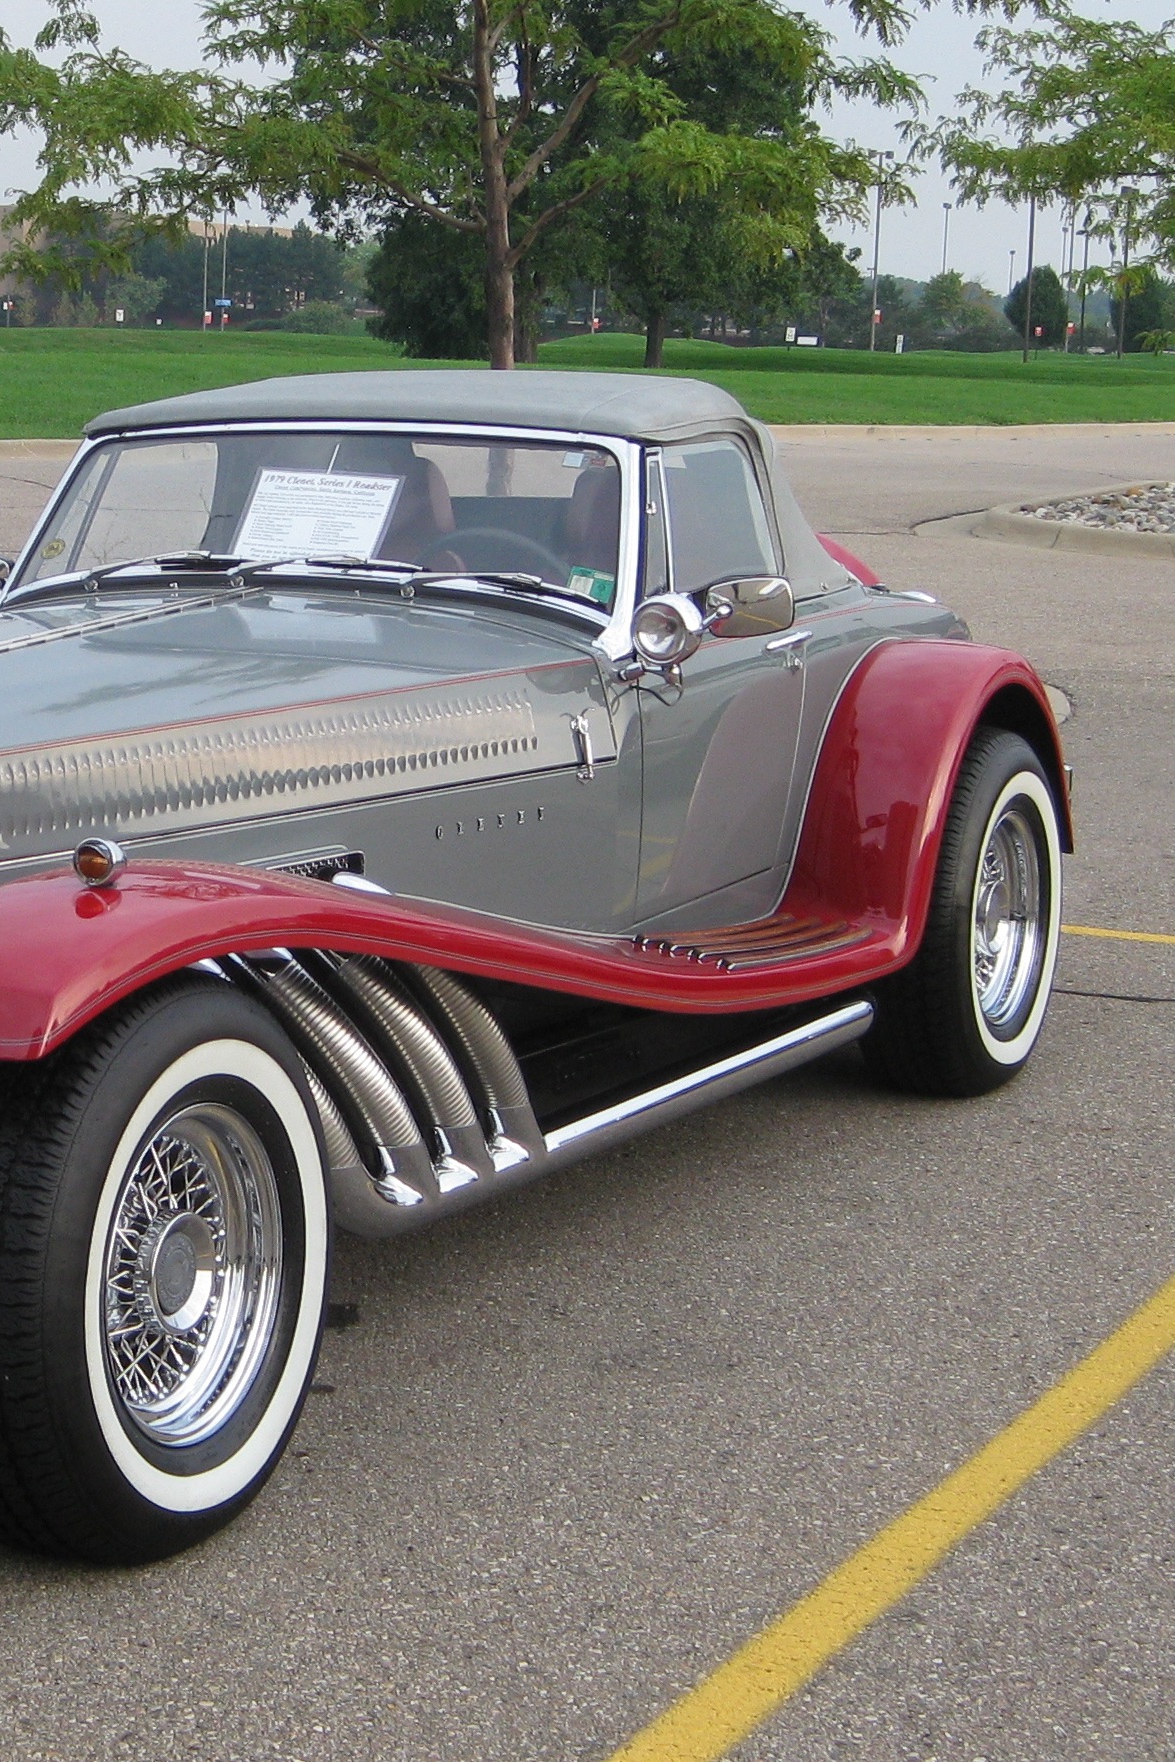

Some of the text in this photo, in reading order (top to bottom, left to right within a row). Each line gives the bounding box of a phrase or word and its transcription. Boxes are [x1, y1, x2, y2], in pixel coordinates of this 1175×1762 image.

[264, 474, 286, 483] 1979
[317, 477, 344, 488] Series
[353, 480, 393, 491] Roadster
